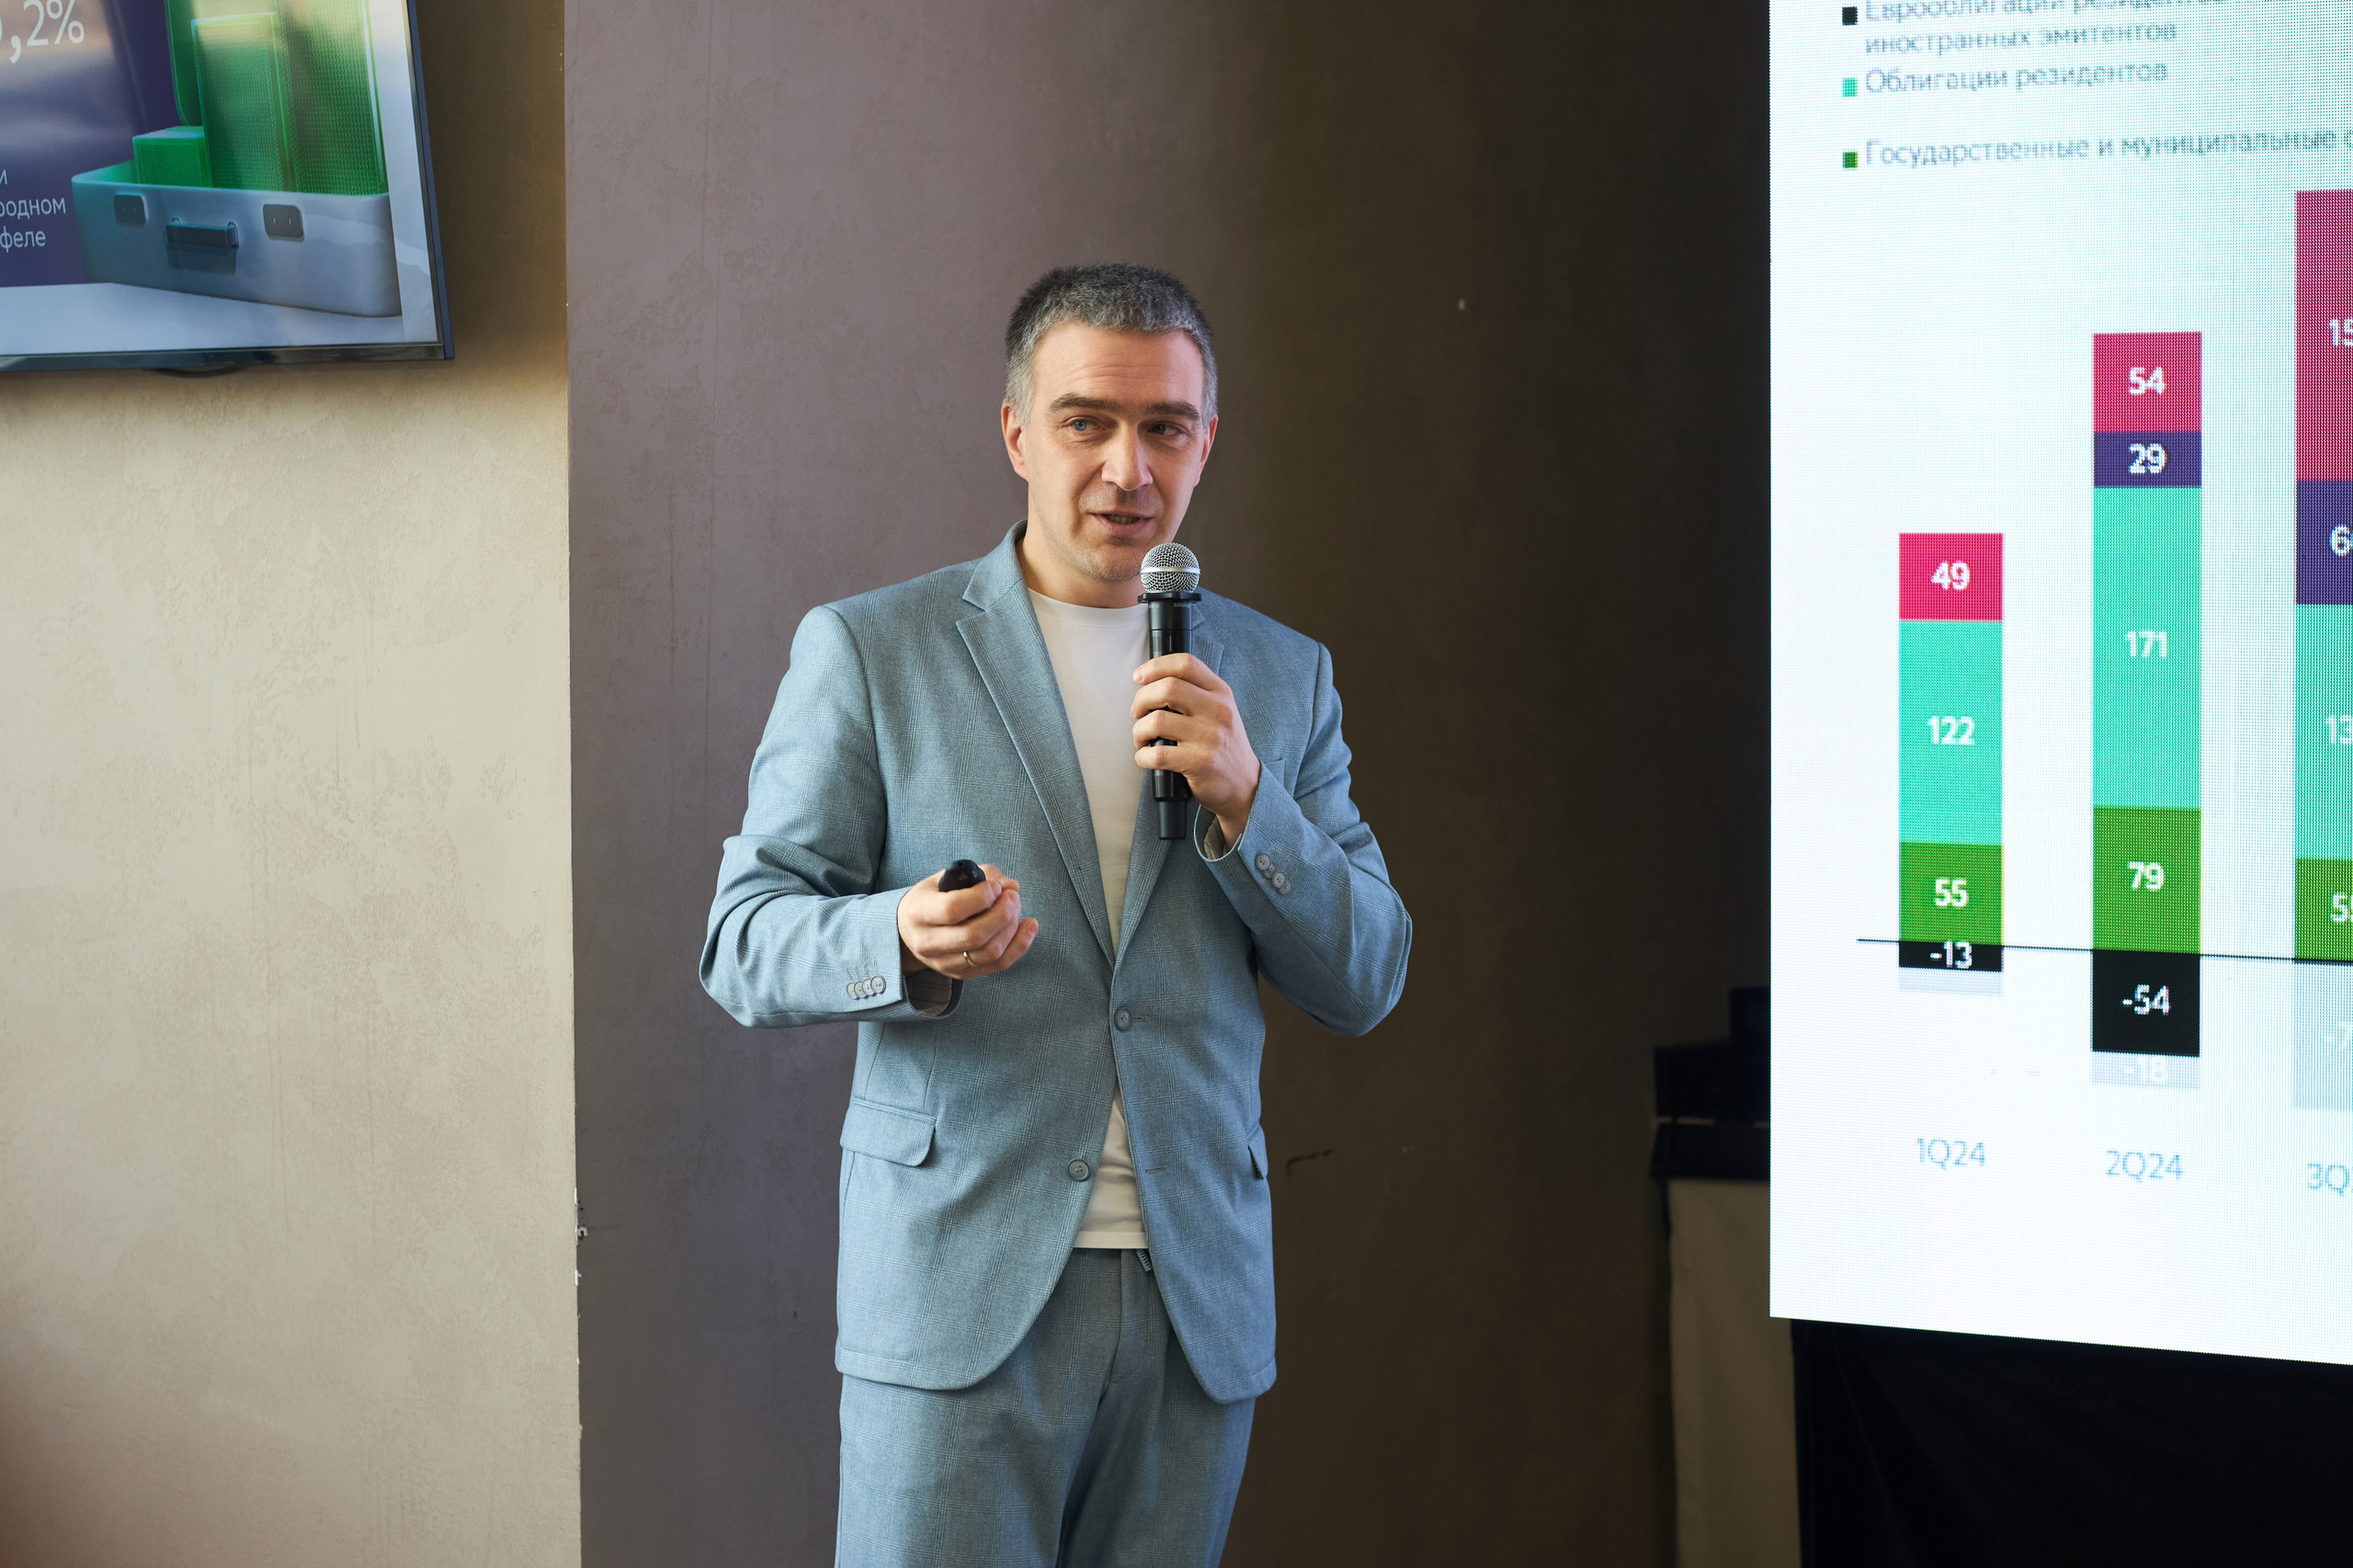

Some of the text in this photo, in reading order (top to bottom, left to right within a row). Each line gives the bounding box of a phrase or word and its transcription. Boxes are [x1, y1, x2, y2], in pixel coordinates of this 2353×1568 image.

[0, 0, 85, 63] ,2%
[1866, 20, 2177, 56] иностранных эмитентов
[1866, 62, 2168, 93] Облигации резидентов
[1866, 138, 2090, 169] Государственные
[2098, 137, 2113, 156] и
[2121, 130, 2336, 161] муниципальные
[2128, 367, 2166, 395] 54
[2128, 443, 2167, 474] 29
[1931, 561, 1970, 590] 49
[2126, 631, 2167, 658] 171
[1928, 716, 1974, 745] 122
[2129, 861, 2165, 891] 79
[1935, 879, 1969, 907] 55
[1930, 941, 1972, 969] -13
[2120, 984, 2170, 1016] -54
[2124, 1056, 2168, 1083] -18
[1915, 1138, 1985, 1170] 1Q24
[2106, 1150, 2184, 1183] 2Q24
